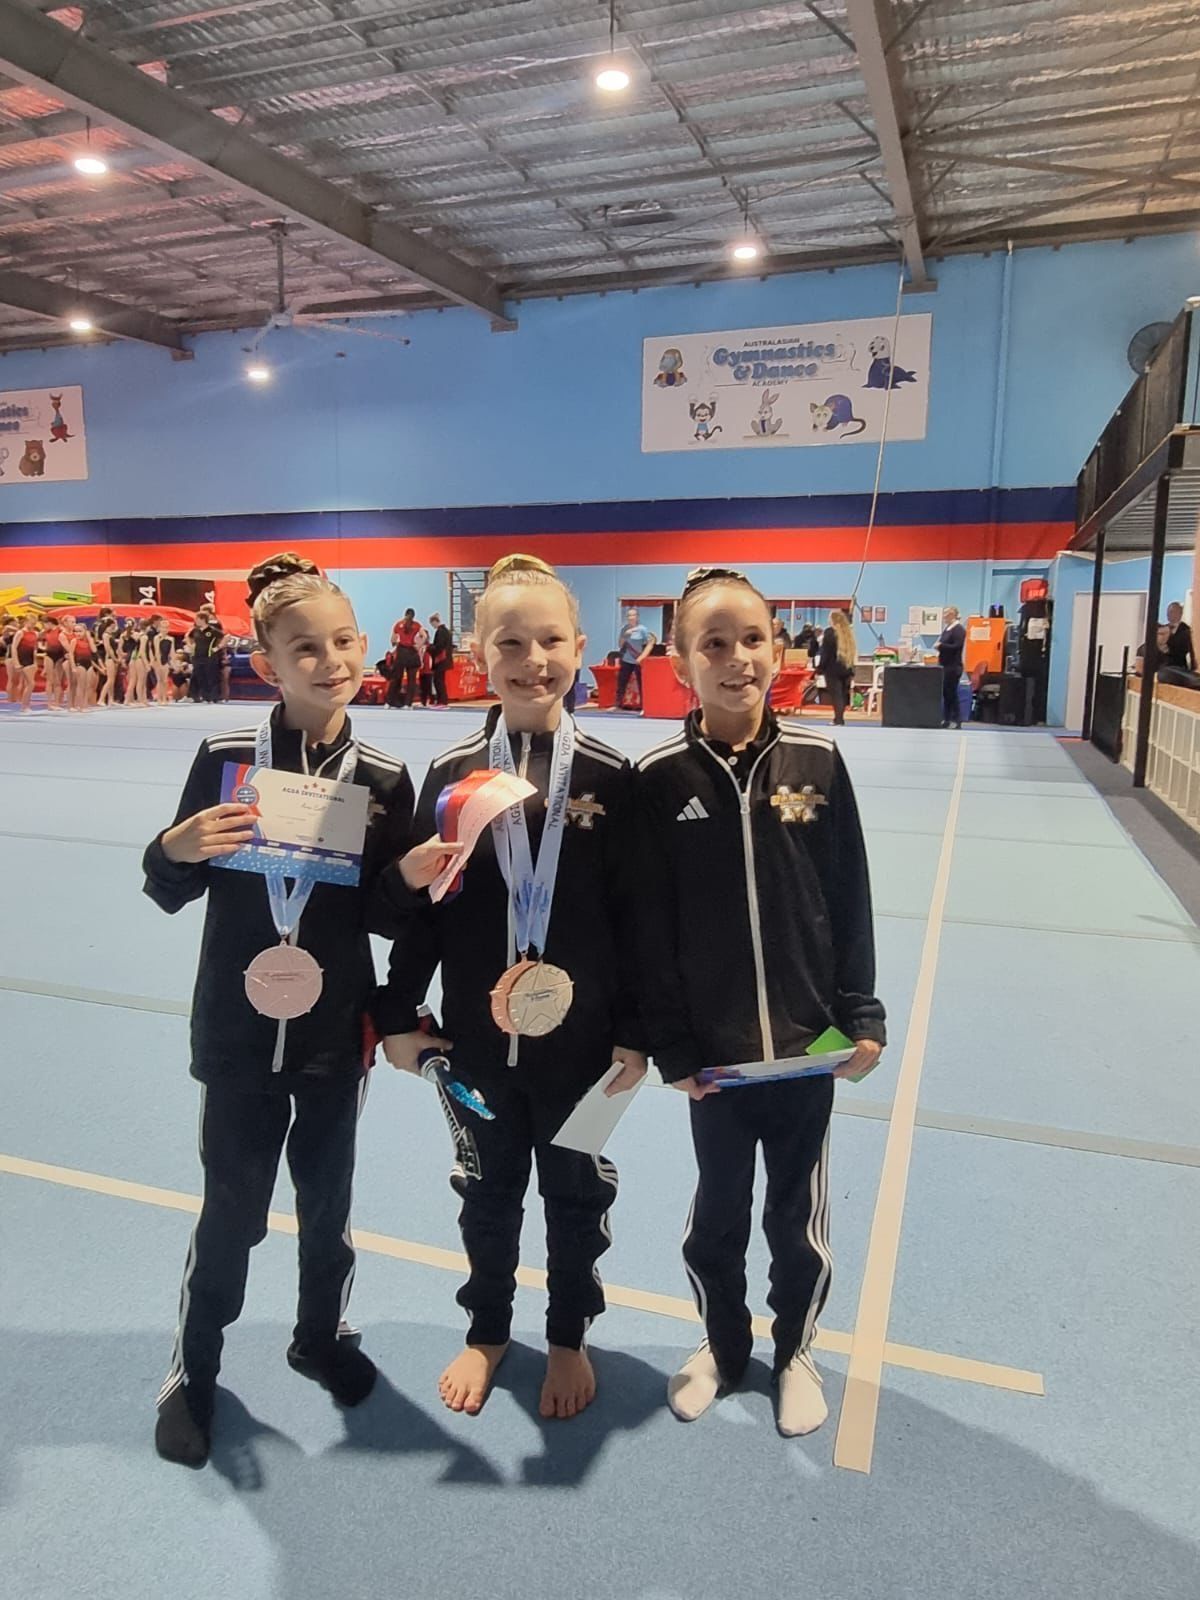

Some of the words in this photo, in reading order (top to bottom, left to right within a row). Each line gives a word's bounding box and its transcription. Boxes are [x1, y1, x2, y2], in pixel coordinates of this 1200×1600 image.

[743, 338, 800, 347] AUSTRALASIAN
[714, 342, 835, 366] Gymnastics
[733, 365, 751, 380] &
[751, 362, 818, 379] Dance
